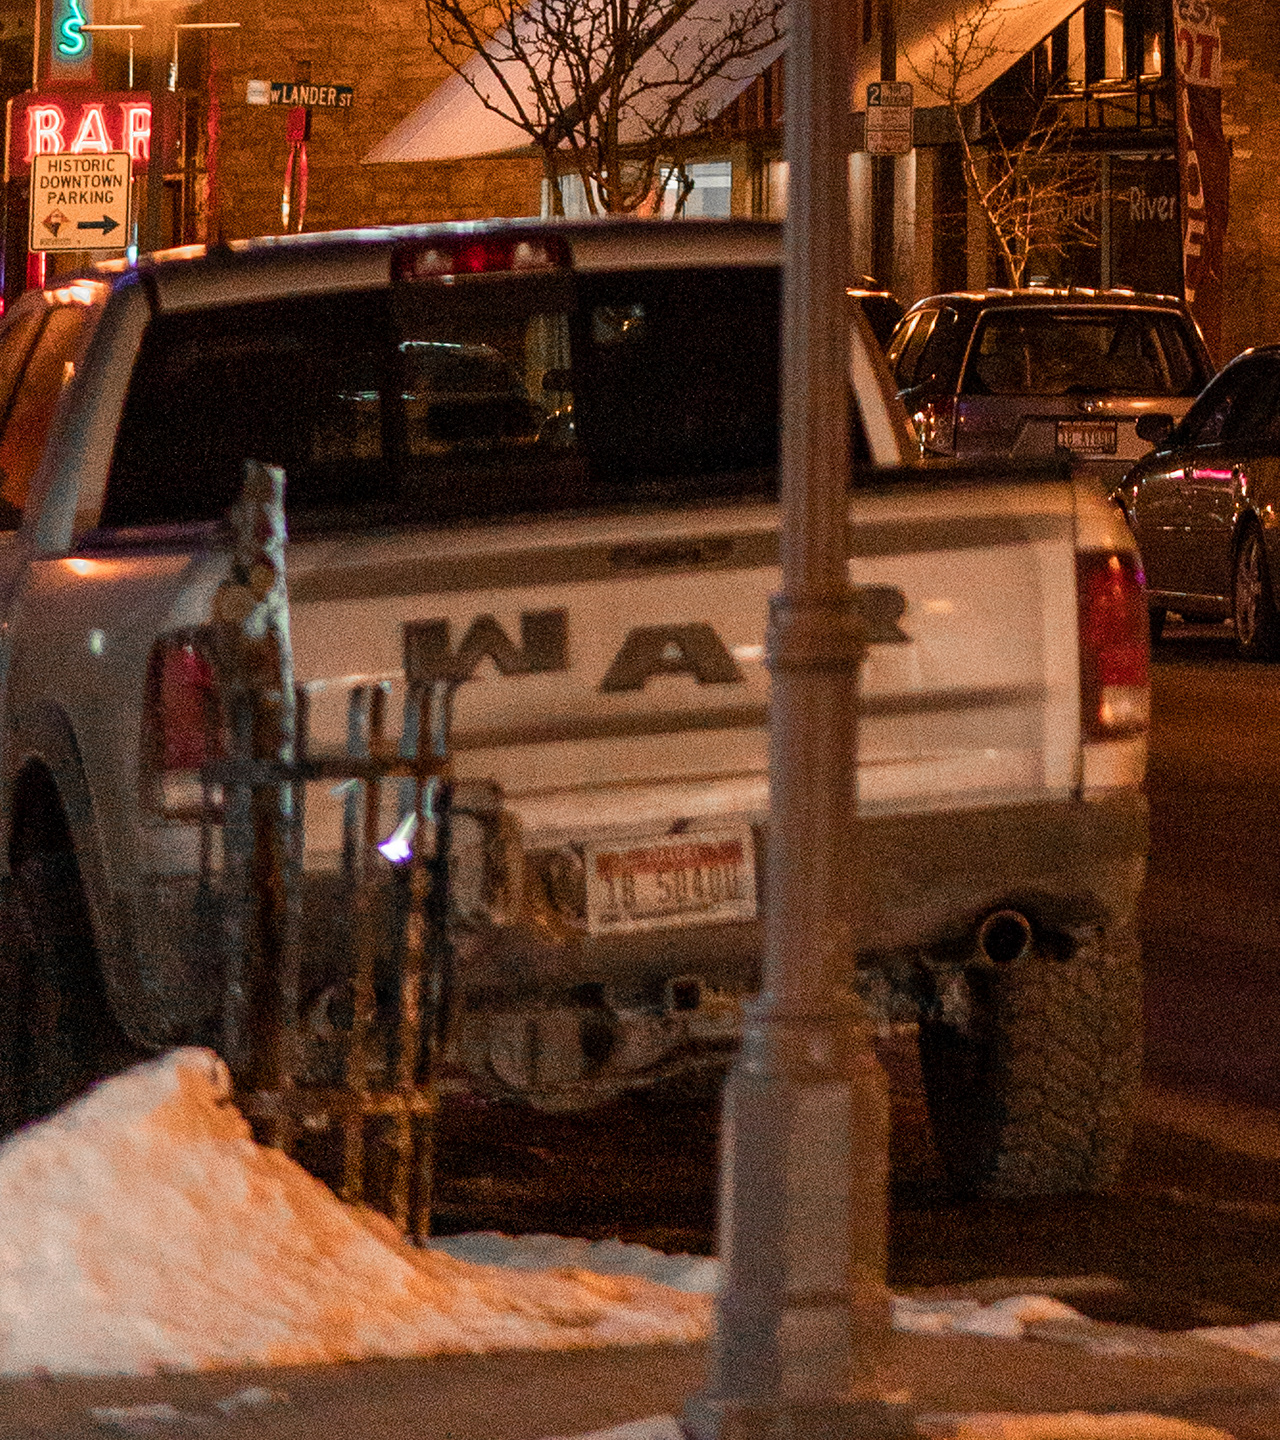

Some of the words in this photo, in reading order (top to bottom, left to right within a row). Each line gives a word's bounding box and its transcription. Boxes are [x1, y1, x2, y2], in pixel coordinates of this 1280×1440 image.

[271, 89, 281, 103] W
[282, 85, 337, 107] LANDER
[338, 93, 352, 107] ST
[869, 85, 880, 105] 2
[24, 102, 152, 162] BAR
[47, 158, 115, 173] HISTORIC
[40, 174, 122, 189] DOWNTOWN
[47, 190, 114, 205] PARKING
[1129, 186, 1176, 222] River
